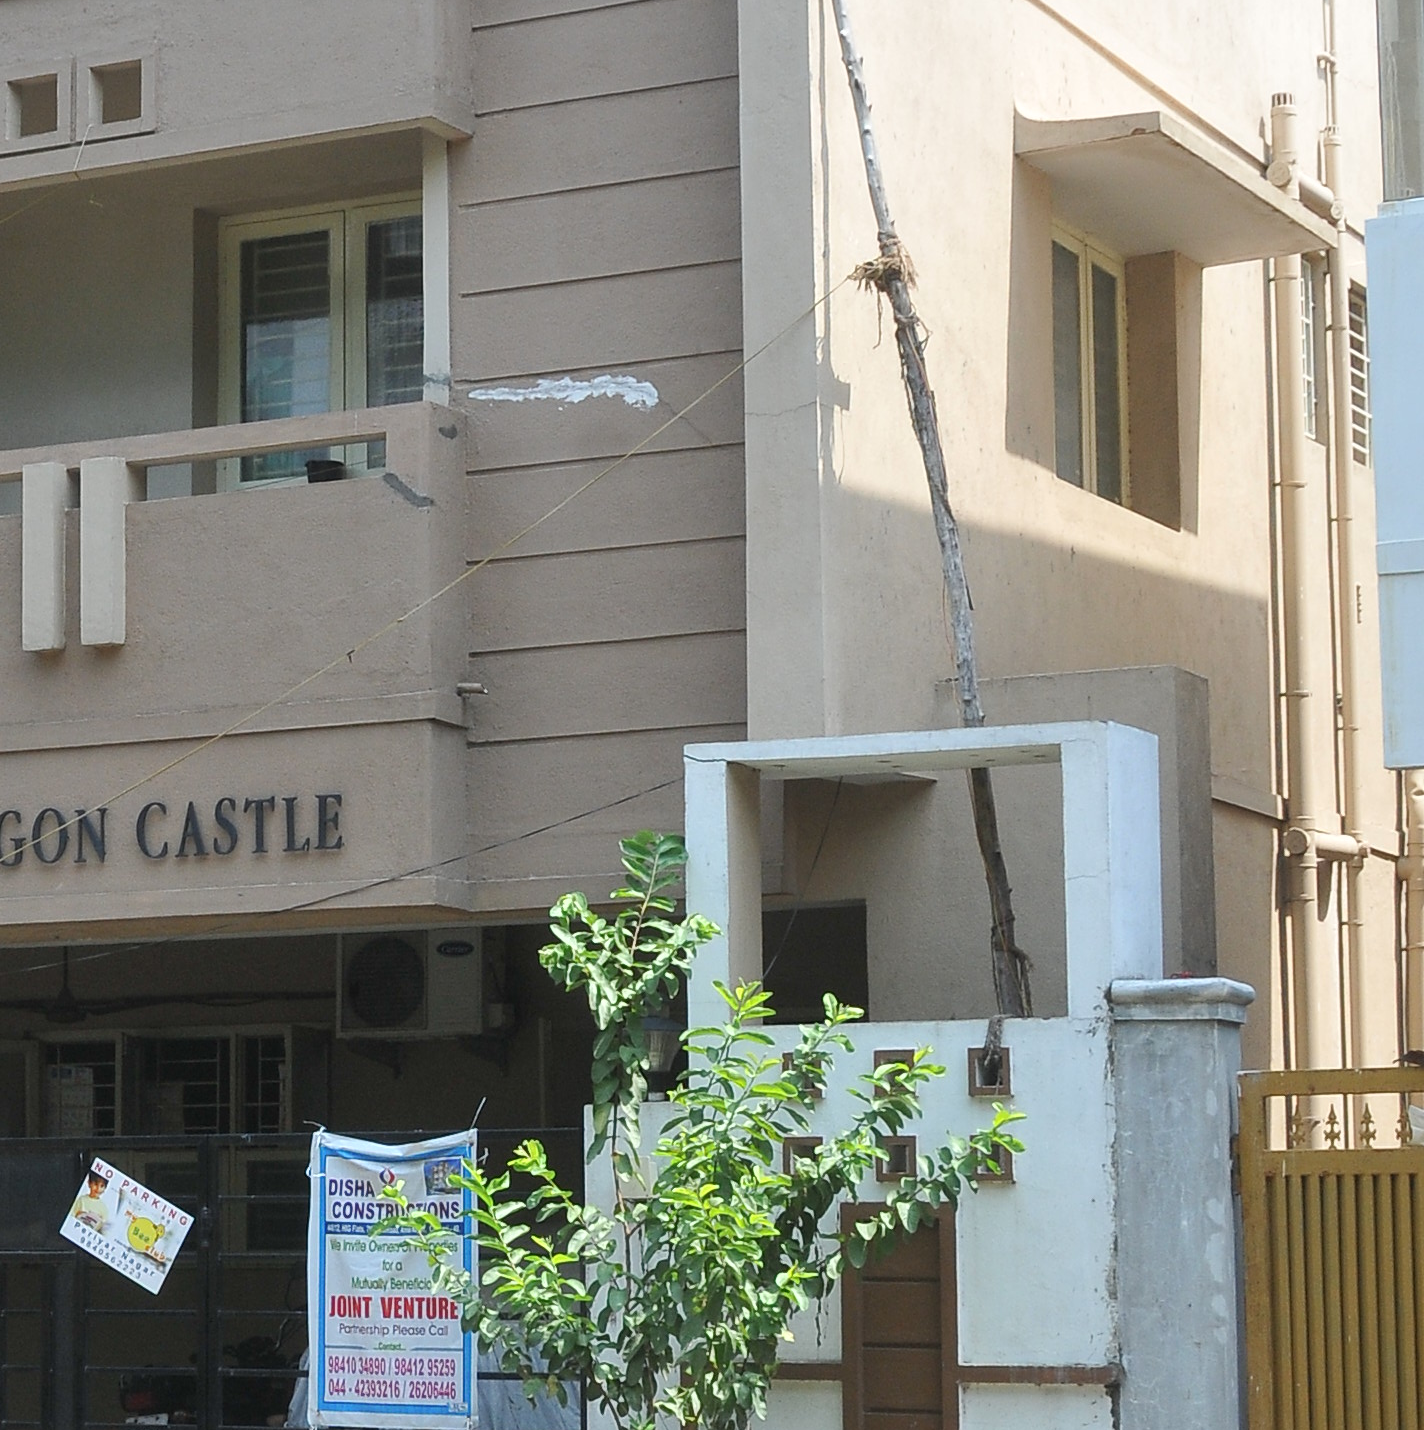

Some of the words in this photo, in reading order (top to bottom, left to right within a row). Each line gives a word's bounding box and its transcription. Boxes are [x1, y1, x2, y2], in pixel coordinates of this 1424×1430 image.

[136, 794, 344, 860] CASTLE
[94, 1162, 114, 1179] NO
[121, 1179, 189, 1226] PARKING
[329, 1179, 375, 1197] DISHA
[132, 1226, 151, 1243] Bee
[344, 1239, 366, 1251] Invite
[121, 1251, 156, 1277] Nagar
[382, 1260, 393, 1270] for
[396, 1262, 403, 1271] a
[351, 1276, 388, 1291] Mutually
[390, 1277, 432, 1290] Beneficia
[329, 1295, 372, 1318] JOINT
[380, 1297, 459, 1319] VENTURE
[339, 1323, 389, 1336] Partnership
[393, 1325, 425, 1336] Please
[429, 1325, 448, 1336] Call
[328, 1356, 356, 1373] 98410
[358, 1357, 386, 1375] 34890
[394, 1358, 424, 1376] 98412
[427, 1359, 456, 1377] 95259
[328, 1378, 346, 1396] 044
[355, 1379, 400, 1398] 42393216
[409, 1381, 456, 1400] 26206446
